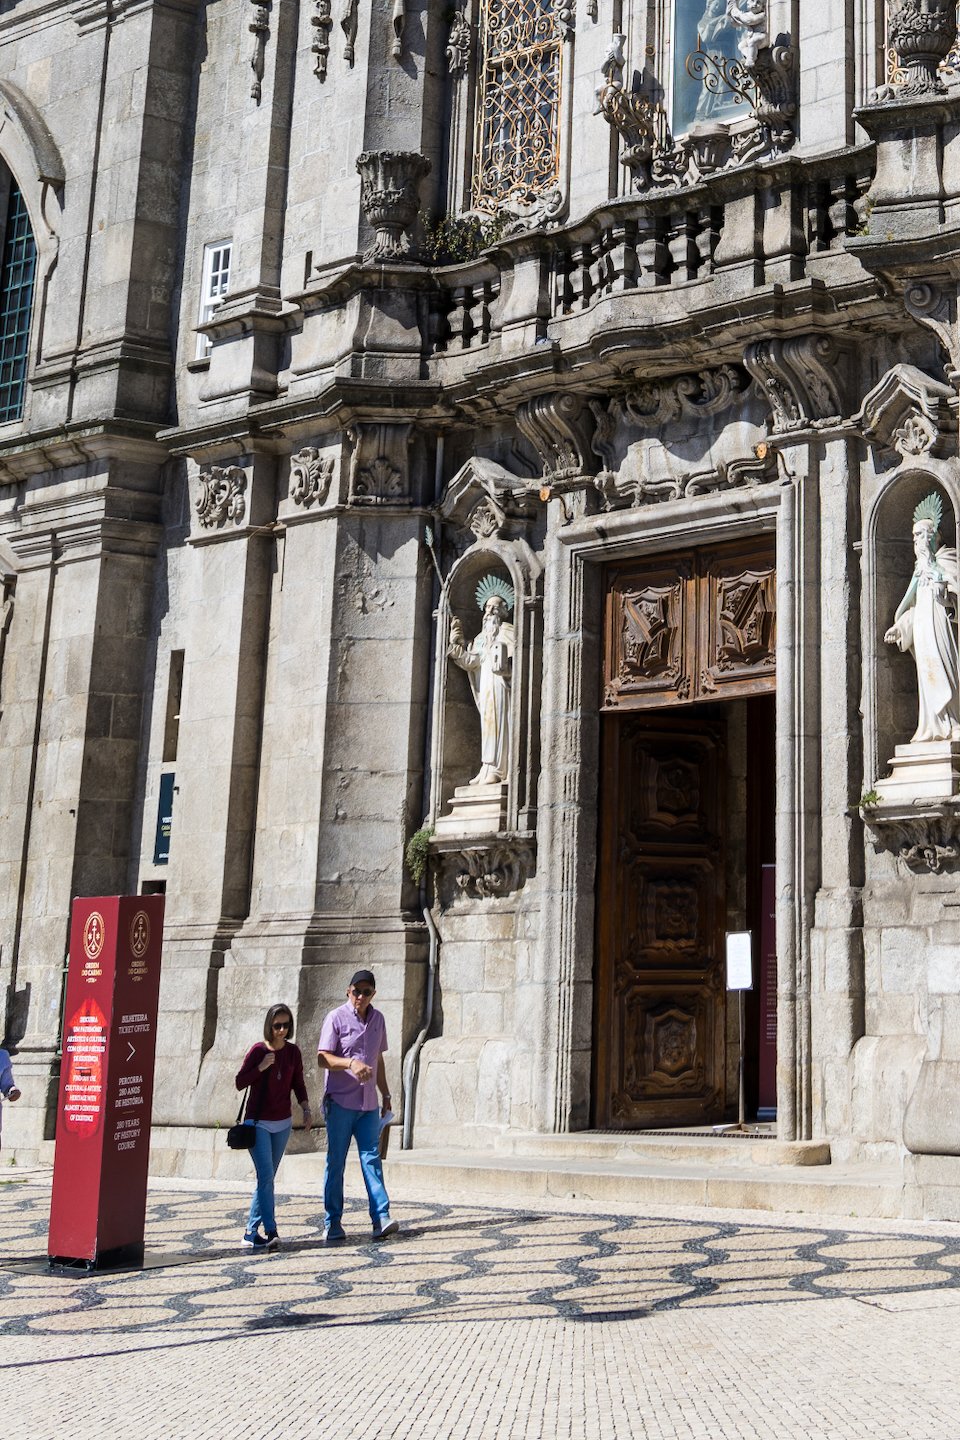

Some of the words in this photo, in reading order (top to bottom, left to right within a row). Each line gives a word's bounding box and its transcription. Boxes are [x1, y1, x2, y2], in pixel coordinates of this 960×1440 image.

[122, 1014, 148, 1023] BILHETEIRA
[119, 1026, 134, 1034] TICKET
[134, 1024, 150, 1032] OFFICE
[119, 1076, 142, 1085] PERCORRA
[128, 1086, 140, 1096] ANOS
[122, 1097, 144, 1107] HISTÓRIA
[126, 1119, 140, 1128] YEARS
[121, 1130, 141, 1140] HISTORY
[118, 1141, 136, 1151] COURSE
